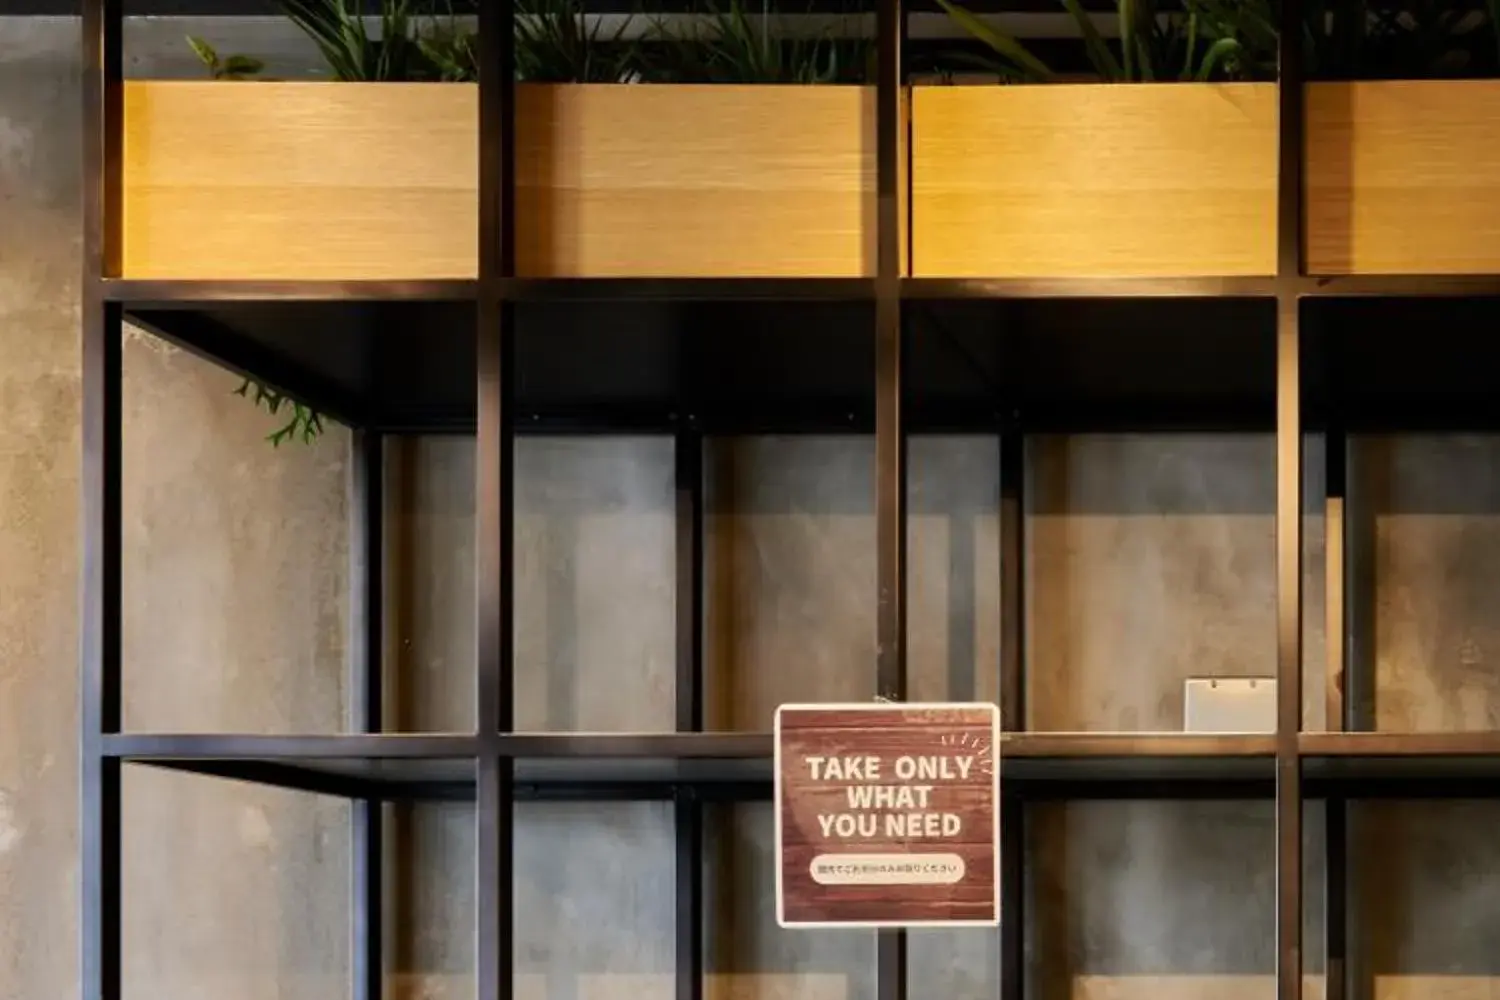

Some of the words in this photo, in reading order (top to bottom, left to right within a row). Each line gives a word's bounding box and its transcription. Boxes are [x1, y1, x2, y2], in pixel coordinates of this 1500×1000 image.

[805, 756, 881, 781] TAKE
[895, 755, 974, 780] ONLY
[846, 785, 934, 809] WHAT
[817, 813, 877, 838] YOU
[885, 812, 961, 837] NEED
